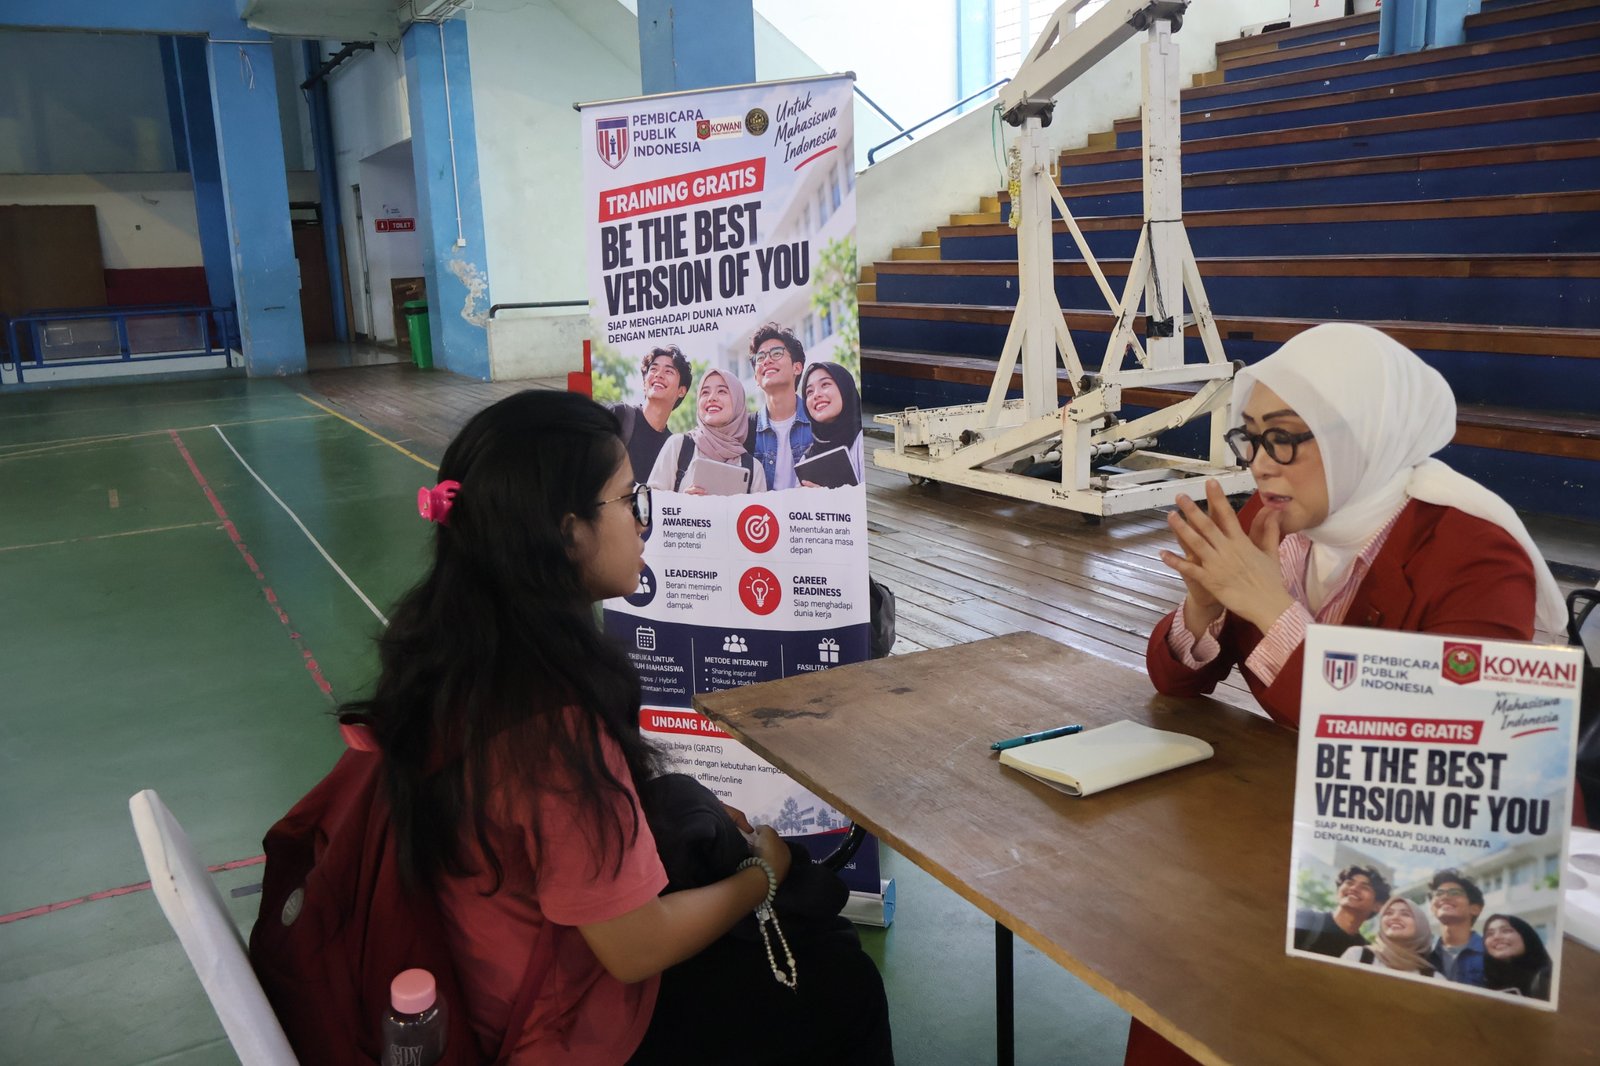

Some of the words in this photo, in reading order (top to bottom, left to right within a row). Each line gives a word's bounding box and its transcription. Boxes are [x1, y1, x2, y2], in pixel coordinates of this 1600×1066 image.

[776, 91, 812, 123] Untuk
[632, 108, 704, 126] PEMBICARA
[710, 121, 742, 132] KOWANI
[774, 105, 838, 147] Mahasiswa
[633, 128, 677, 142] PUBLIK
[633, 141, 701, 157] INDONESIA
[783, 127, 837, 164] Indonesia
[606, 181, 688, 215] TRAINING
[692, 166, 757, 198] GRATIS
[601, 221, 634, 271] BE
[638, 213, 688, 264] THE
[694, 201, 762, 255] BEST
[603, 257, 713, 317] VERSION
[718, 251, 750, 299] OF
[756, 240, 810, 292] YOU
[607, 320, 628, 331] SIAP
[629, 312, 691, 328] MENGHADAPI
[692, 308, 723, 321] DUNIA
[725, 303, 756, 316] NYATA
[608, 330, 646, 344] DENGAN
[647, 326, 686, 339] MENTAL
[687, 321, 719, 333] JUARA
[662, 507, 682, 516] SELF
[789, 512, 813, 522] GOAL
[815, 512, 852, 523] SETTING
[662, 518, 712, 528] AWARENESS
[663, 530, 694, 540] Mengenal
[696, 531, 707, 540] diri
[789, 525, 833, 535] Menentukan
[834, 527, 850, 536] arah
[663, 540, 676, 548] dan
[677, 541, 702, 551] potensi
[790, 536, 804, 544] dan
[805, 538, 833, 546] rencana
[790, 546, 812, 555] depan
[665, 569, 718, 580] LEADERSHIP
[792, 576, 828, 586] CAREER
[666, 581, 687, 590] Berani
[688, 583, 722, 593] memimpin
[793, 586, 842, 597] READINESS
[666, 591, 679, 599] dan
[680, 592, 710, 601] memberi
[666, 601, 694, 611] dampak
[793, 599, 809, 609] Siap
[810, 601, 853, 611] menghadapi
[793, 609, 814, 618] dunia
[814, 610, 833, 620] kerja
[646, 663, 684, 672] MAHASISWA
[704, 656, 731, 665] METODE
[732, 658, 768, 668] INTERAKTIF
[1362, 654, 1440, 671] PEMBICARA
[712, 668, 732, 676] Sharing
[732, 669, 757, 678] inspiratif
[1362, 666, 1409, 680] PUBLIK
[1484, 656, 1577, 682] KOWANI
[712, 677, 730, 685] Diskusi
[1361, 679, 1434, 695] INDONESIA
[662, 686, 686, 694] kampus)
[652, 716, 698, 730] UNDANG
[1500, 711, 1559, 731] Indonesia
[1325, 719, 1407, 737] TRAINING
[1411, 722, 1474, 741] GRATIS
[674, 742, 692, 752] biaya
[694, 744, 724, 755] (GRATIS)
[694, 758, 719, 768] dengan
[720, 761, 756, 772] kebutuhan
[758, 764, 785, 774] kampu
[1315, 743, 1352, 780] BE
[1360, 745, 1418, 785] THE
[1426, 748, 1508, 790] BEST
[698, 774, 742, 785] offline/online
[1315, 782, 1435, 826] VERSION
[1442, 792, 1480, 830] OF
[1487, 796, 1550, 836] YOU
[1314, 820, 1338, 830] SIAP
[1340, 822, 1414, 840] MENGHADAPI
[1416, 832, 1452, 844] DUNIA
[1454, 836, 1492, 849] NYATA
[1314, 830, 1360, 844] DENGAN
[1362, 836, 1406, 850] MENTAL
[1408, 842, 1446, 856] JUARA
